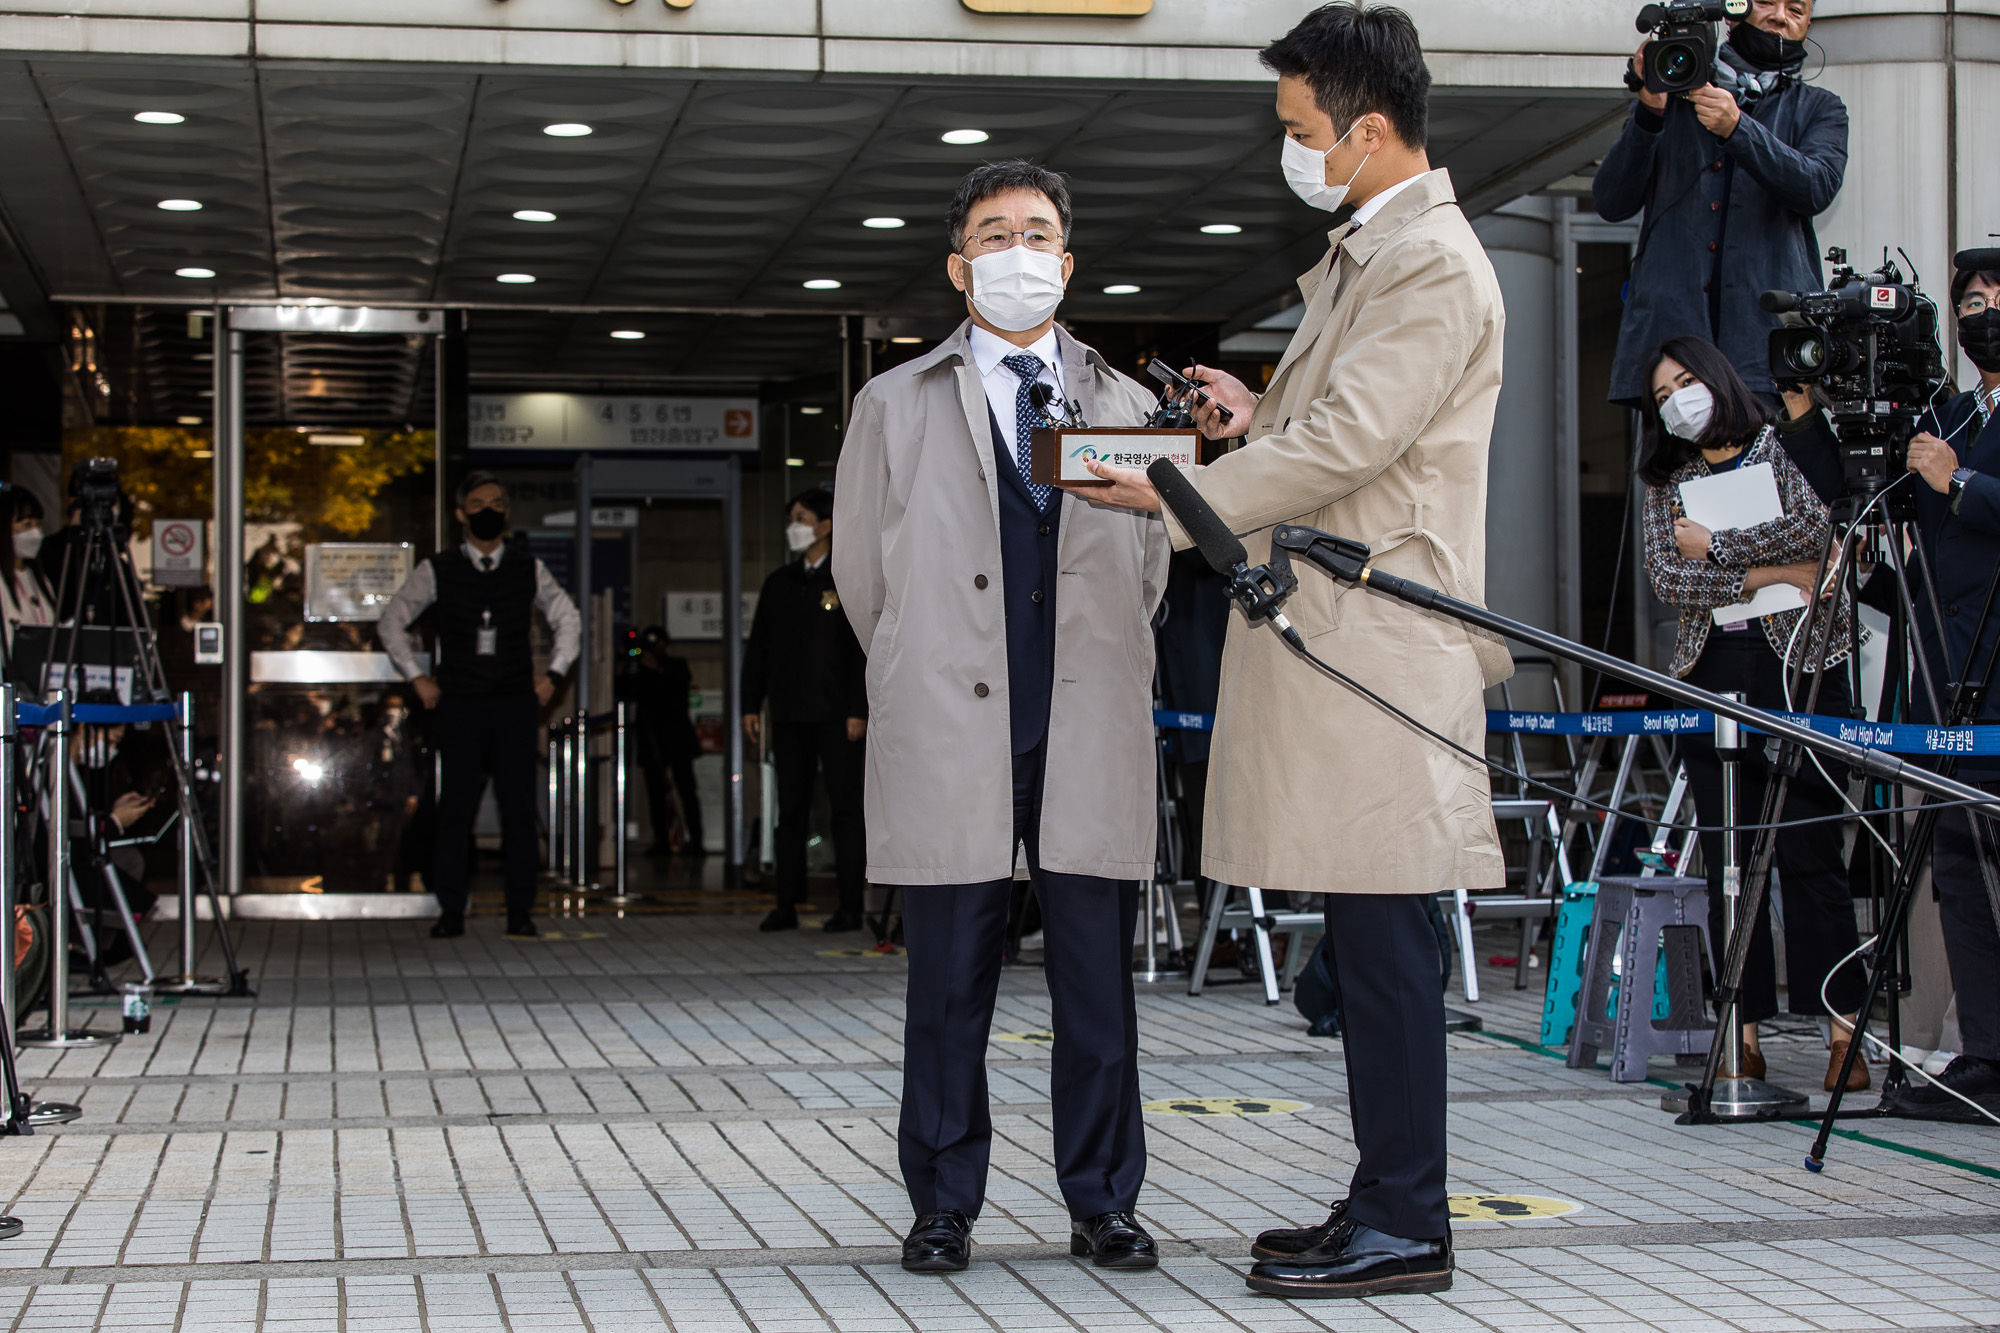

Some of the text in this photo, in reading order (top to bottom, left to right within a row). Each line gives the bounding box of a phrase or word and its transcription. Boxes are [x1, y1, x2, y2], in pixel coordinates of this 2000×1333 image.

[1509, 714, 1555, 730] Seoul High Court
[1582, 715, 1613, 733] 서울고등법원
[1643, 713, 1699, 731] Seoul High Court
[1839, 723, 1893, 746] Seoul High Court
[1926, 729, 1974, 752] 서울고등법원
